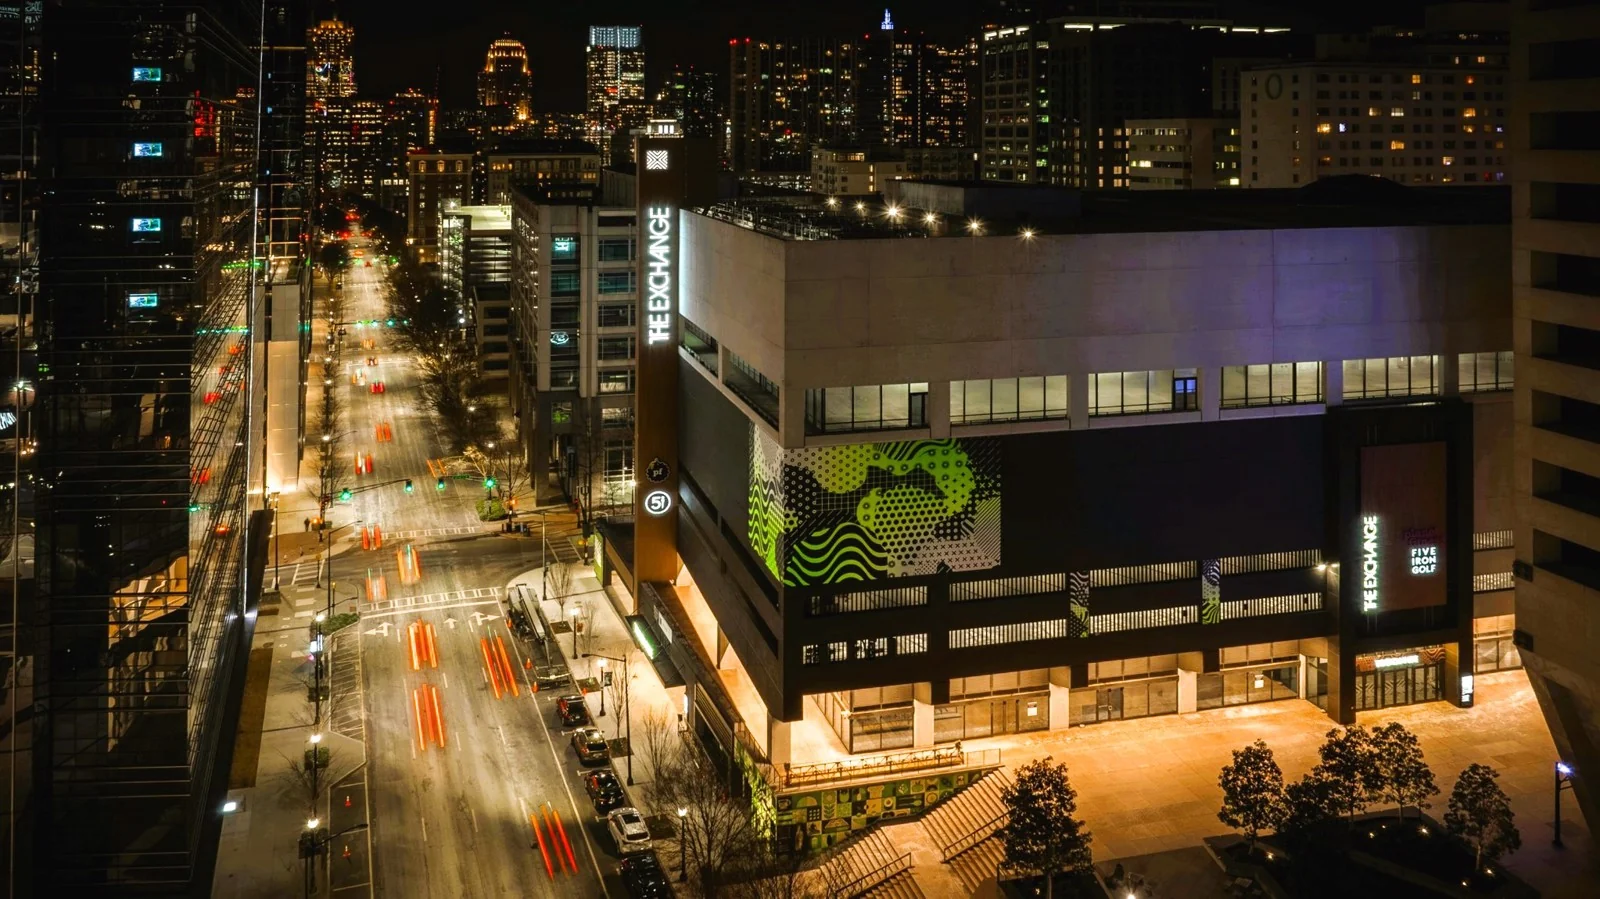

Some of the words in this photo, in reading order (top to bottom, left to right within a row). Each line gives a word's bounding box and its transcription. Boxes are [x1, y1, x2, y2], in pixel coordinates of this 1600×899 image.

[648, 207, 670, 311] EXCHANGE
[648, 312, 670, 345] THE
[1363, 515, 1378, 589] EXCHANGE
[1411, 546, 1437, 558] FIVE
[1411, 555, 1437, 566] IRON
[1411, 564, 1437, 575] GOLF
[1363, 589, 1378, 612] THE
